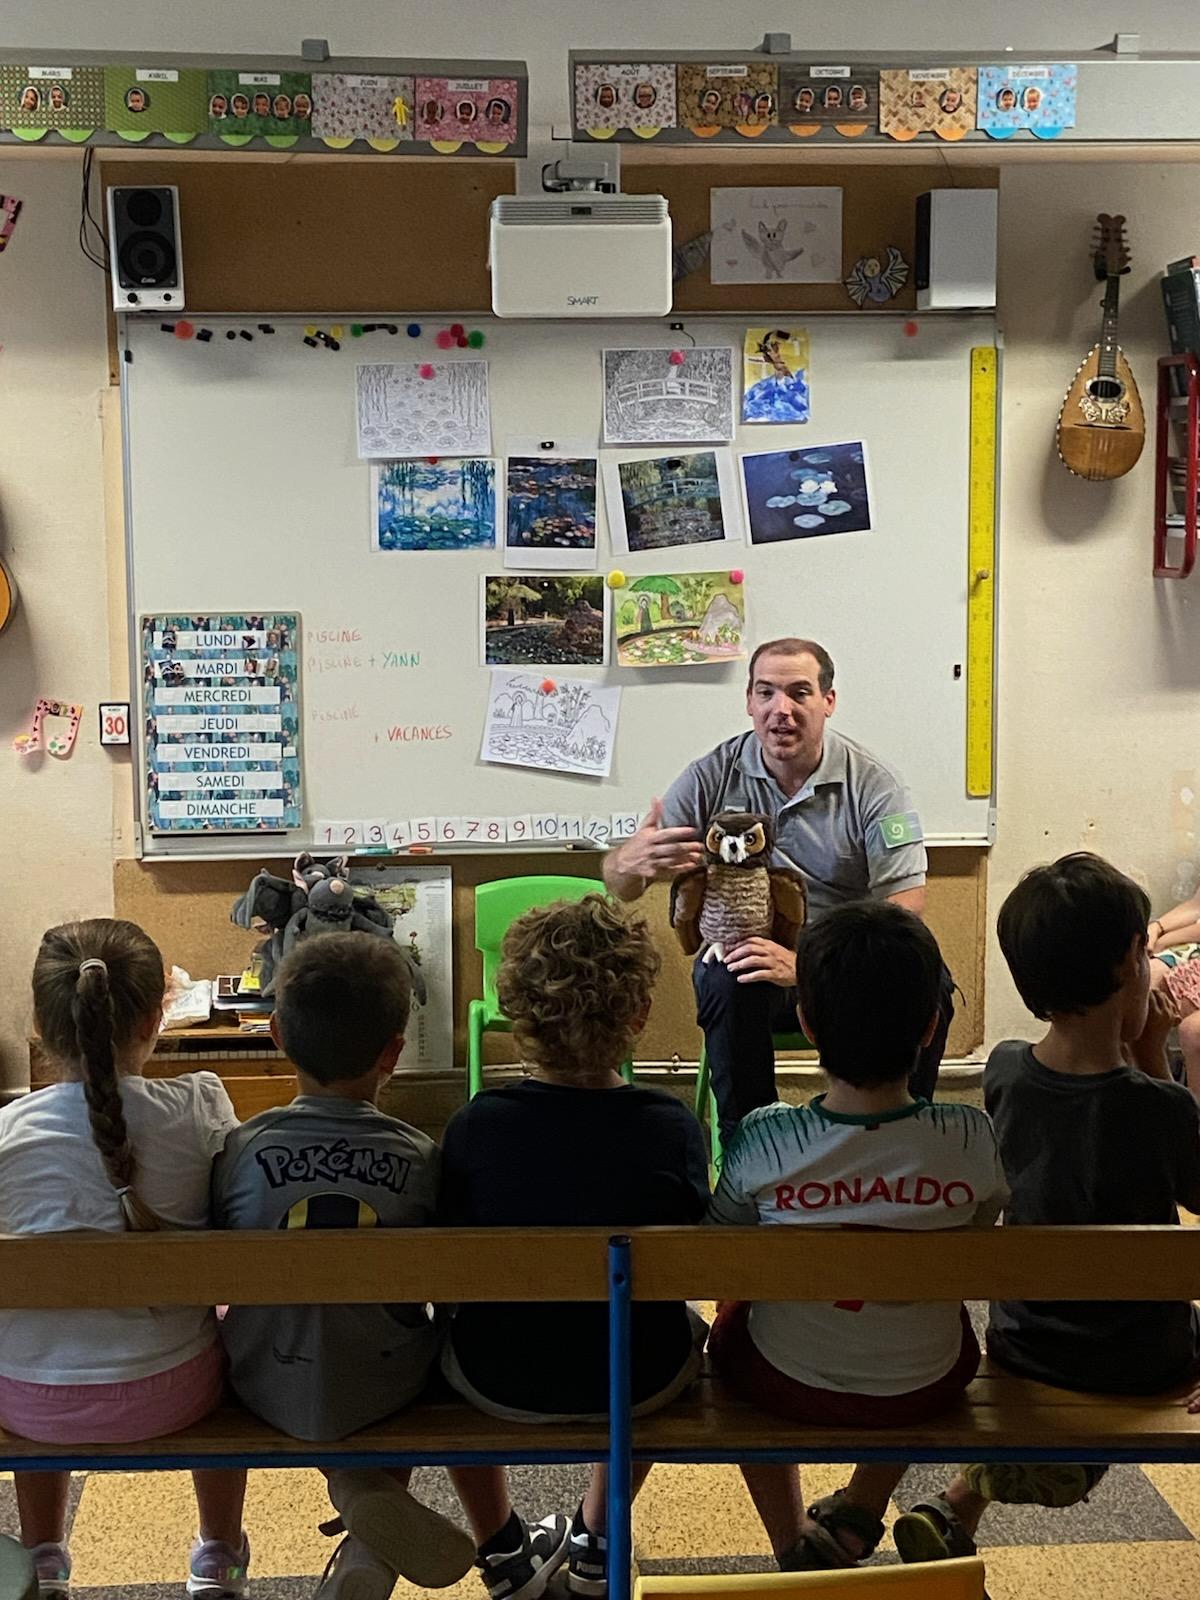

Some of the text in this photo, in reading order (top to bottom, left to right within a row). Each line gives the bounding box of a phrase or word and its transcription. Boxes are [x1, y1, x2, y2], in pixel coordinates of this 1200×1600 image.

[567, 295, 599, 306] SMART
[196, 634, 236, 646] LUNDI
[307, 628, 362, 643] PISCINE
[382, 651, 421, 669] YANN
[196, 662, 238, 675] MARDI
[184, 690, 251, 703] MERCREDI
[105, 716, 125, 736] 30
[200, 718, 238, 730] JEUDI
[387, 725, 453, 742] VACANCES
[184, 746, 250, 759] VENDREDI
[196, 775, 245, 787] SAMEDI
[187, 803, 256, 816] DIMANCHE
[325, 817, 637, 844] 1 2 3 4 5 6 7 8 9 10 11 12 13
[775, 1176, 974, 1211] RONALDO
